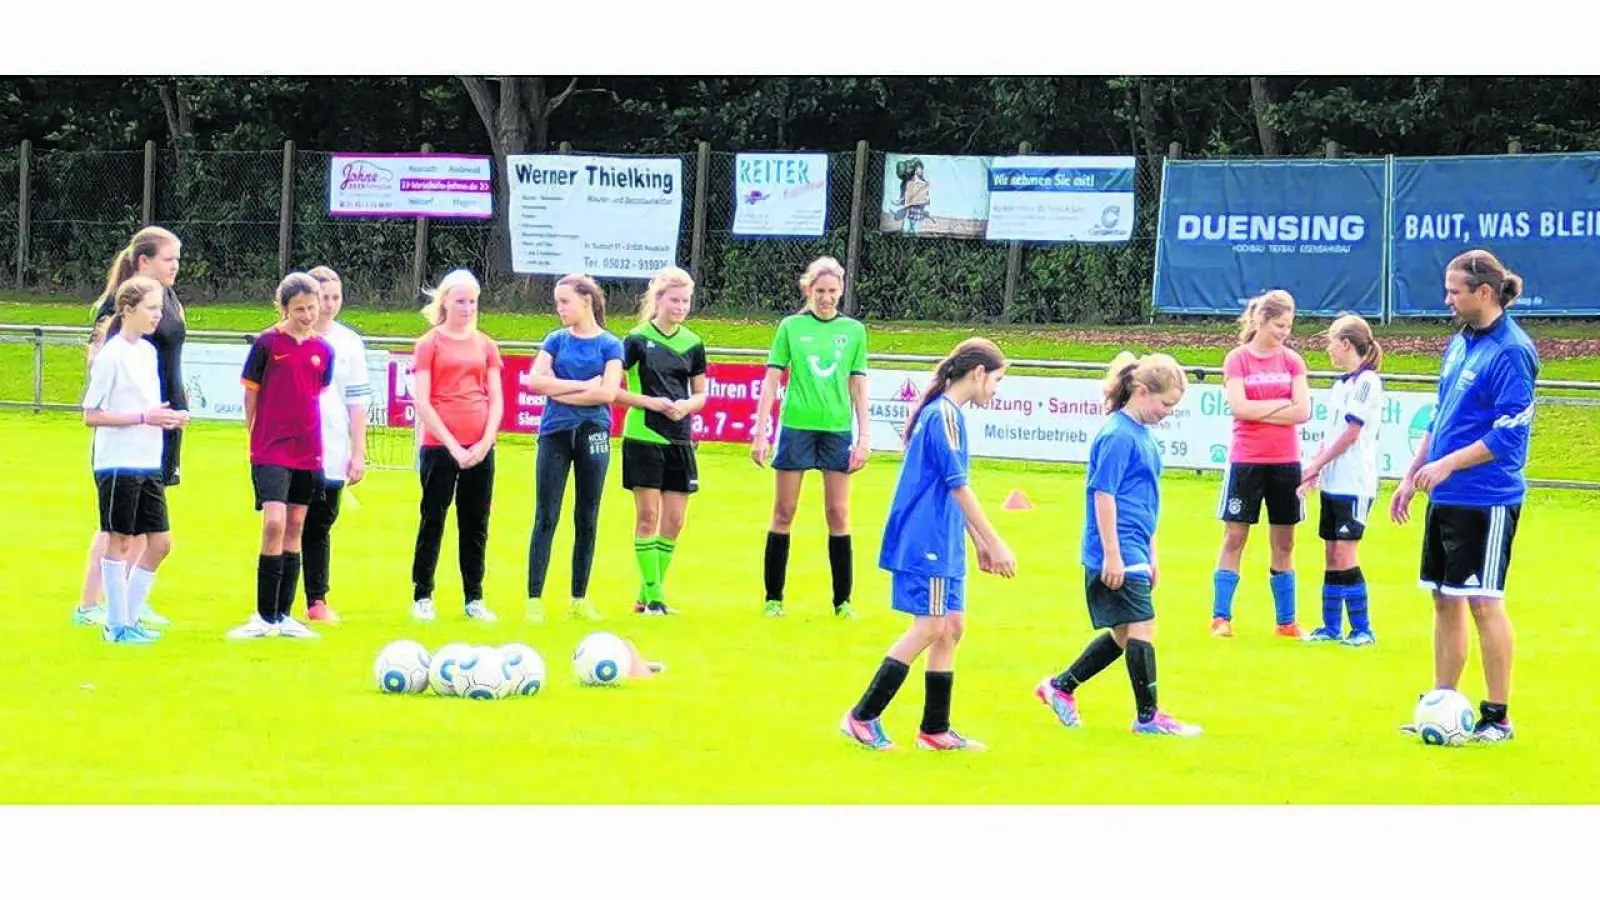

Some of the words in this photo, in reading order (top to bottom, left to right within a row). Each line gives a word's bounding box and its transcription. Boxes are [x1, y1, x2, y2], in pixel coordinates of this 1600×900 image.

[515, 164, 579, 185] Werner
[585, 165, 673, 194] Thielking
[740, 159, 811, 184] REITER
[993, 173, 1008, 186] Wir
[1054, 173, 1071, 186] Sie
[1177, 214, 1366, 241] DUENSING
[1404, 213, 1470, 243] BAUT,
[1478, 211, 1530, 239] WAS
[714, 411, 728, 436] 7
[984, 423, 1088, 442] Meisterbetrieb
